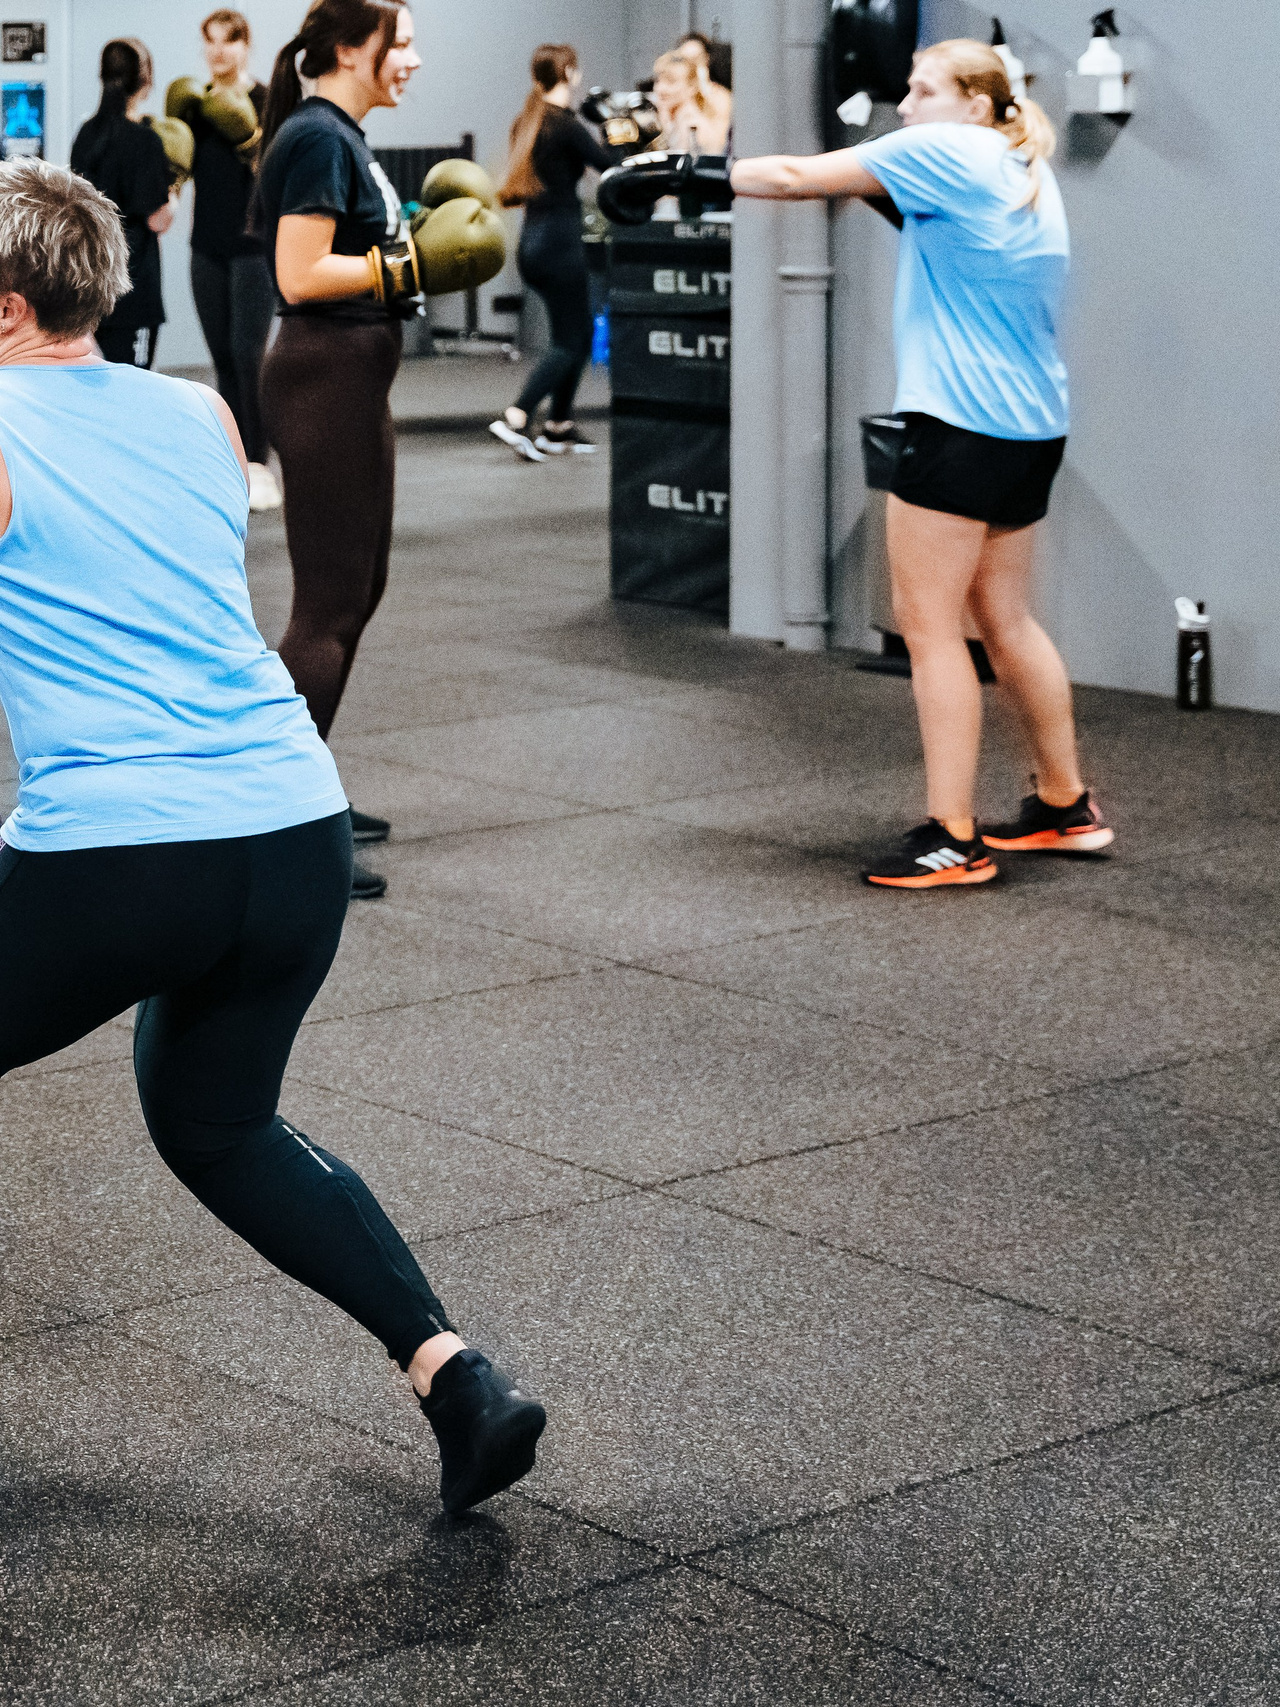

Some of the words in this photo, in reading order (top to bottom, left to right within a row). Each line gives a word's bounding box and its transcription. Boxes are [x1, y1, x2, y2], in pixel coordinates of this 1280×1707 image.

[653, 269, 730, 296] ELIT
[649, 330, 729, 359] ELIT
[648, 484, 728, 515] ELIT
